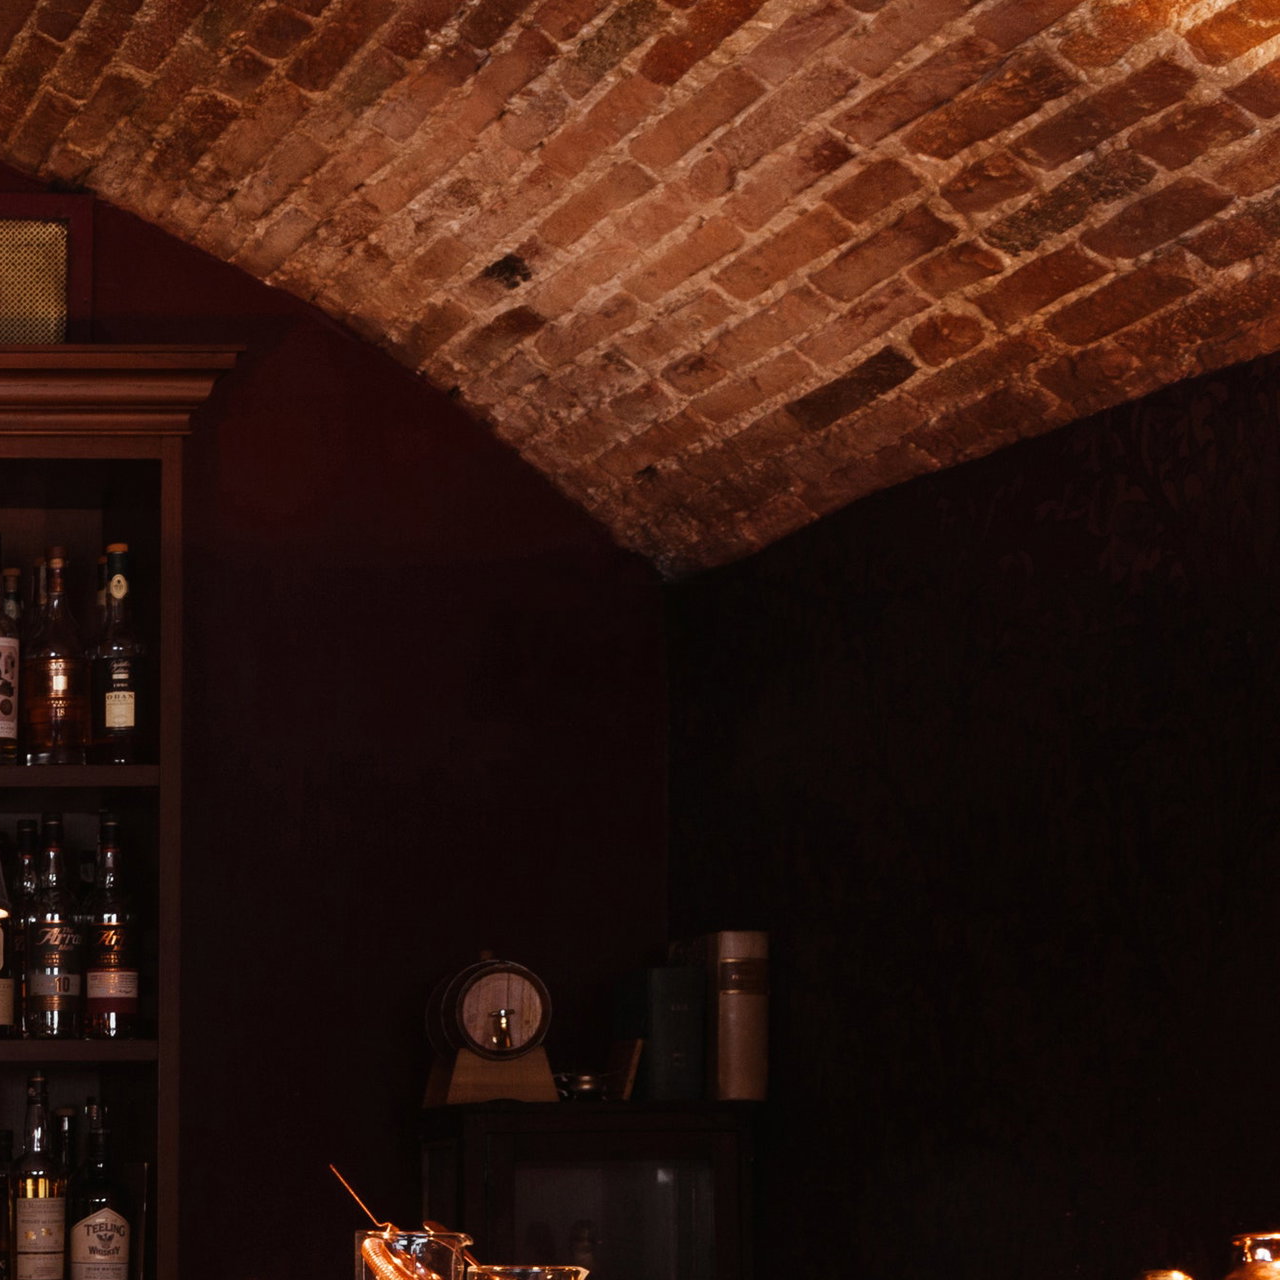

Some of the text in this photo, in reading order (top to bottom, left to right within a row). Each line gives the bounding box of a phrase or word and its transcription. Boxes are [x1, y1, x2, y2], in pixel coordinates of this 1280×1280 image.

[55, 976, 70, 993] 10
[84, 1222, 126, 1237] TEELING
[88, 1246, 121, 1257] WHISKEY
